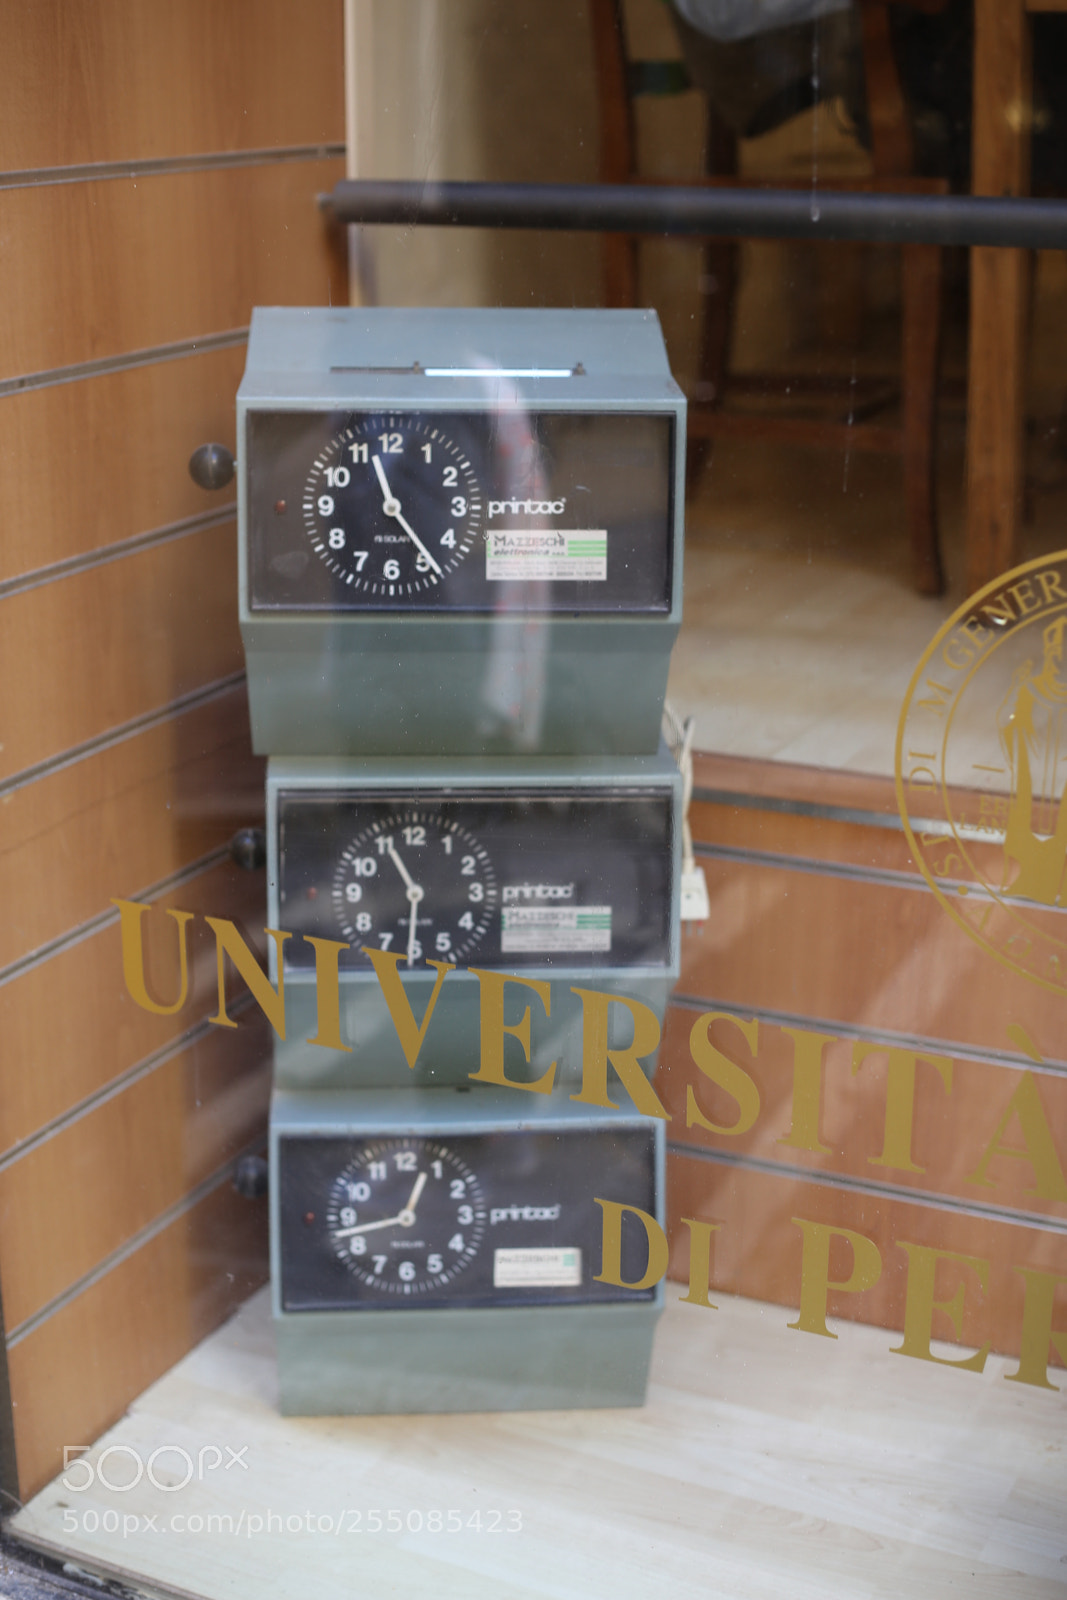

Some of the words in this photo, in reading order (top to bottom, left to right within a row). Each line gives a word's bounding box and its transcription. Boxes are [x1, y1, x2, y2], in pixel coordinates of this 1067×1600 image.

[348, 443, 368, 463] 11
[378, 433, 403, 454] 12
[421, 443, 432, 463] 1
[323, 466, 350, 488] 10
[442, 466, 458, 487] 2
[317, 495, 335, 516] 9
[451, 496, 467, 517] 3
[328, 528, 345, 549] 8
[440, 529, 457, 549] 4
[353, 551, 369, 572] 7
[383, 559, 400, 580] 6
[415, 551, 431, 573] 5
[375, 836, 394, 855] 11
[402, 826, 426, 846] 12
[441, 835, 452, 855] 1
[352, 857, 377, 877] 10
[461, 855, 476, 875] 2
[346, 883, 362, 903] 9
[468, 882, 484, 902] 3
[356, 912, 372, 932] 8
[458, 911, 474, 930] 4
[378, 932, 394, 951] 7
[435, 932, 451, 952] 5
[110, 898, 1067, 1202] UNIVERSITÀ
[367, 1161, 387, 1181] 11
[393, 1151, 418, 1171] 12
[430, 1160, 442, 1179] 1
[346, 1182, 371, 1202] 10
[450, 1179, 466, 1199] 2
[340, 1206, 357, 1227] 9
[457, 1205, 474, 1225] 3
[350, 1235, 367, 1256] 8
[448, 1233, 465, 1252] 4
[427, 1254, 443, 1273] 5
[593, 1197, 721, 1310] DI
[372, 1255, 388, 1275] 7
[399, 1261, 416, 1281] 6
